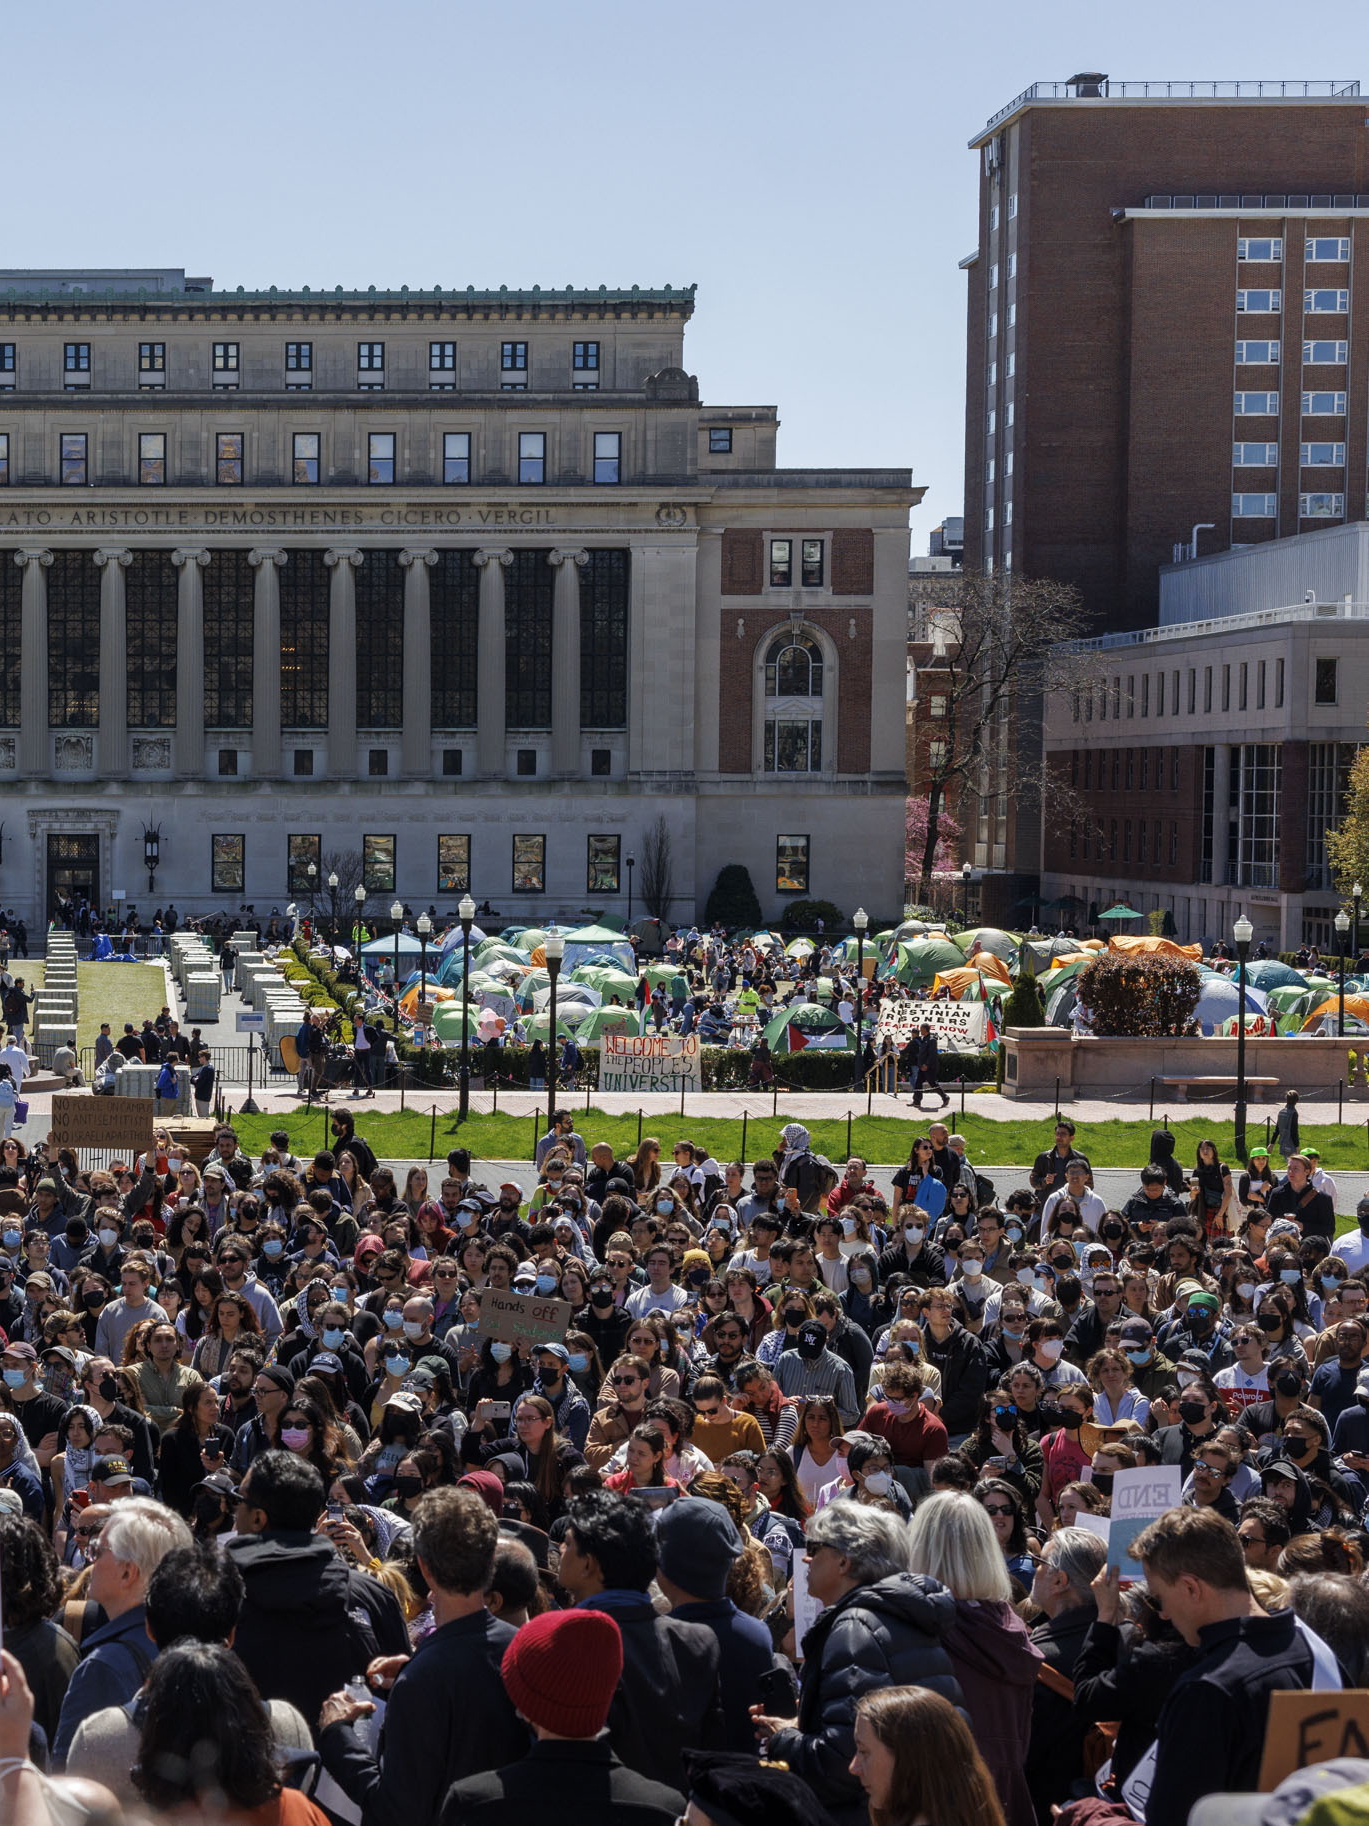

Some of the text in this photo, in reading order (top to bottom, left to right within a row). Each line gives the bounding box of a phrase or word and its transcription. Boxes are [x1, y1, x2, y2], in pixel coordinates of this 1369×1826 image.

[70, 511, 189, 526] ARISTOTLE
[205, 511, 363, 526] DEMOSTHENES
[381, 511, 461, 526] CICERO
[477, 511, 556, 526] VERGIL
[891, 1006, 971, 1018] LESTINIAN
[885, 1013, 967, 1026] RISONERS
[878, 1021, 969, 1035] CEAEFIE NOW
[605, 1036, 696, 1057] WELCOME TO
[604, 1054, 693, 1075] THE PEOPLE'S
[603, 1071, 697, 1093] UNIVERSITY
[54, 1098, 70, 1110] NO
[72, 1100, 103, 1111] POLICE
[53, 1112, 152, 1127] NO ANTISEMITISM
[53, 1130, 69, 1143] NO
[491, 1298, 560, 1320] Hands off
[805, 1333, 817, 1346] NY
